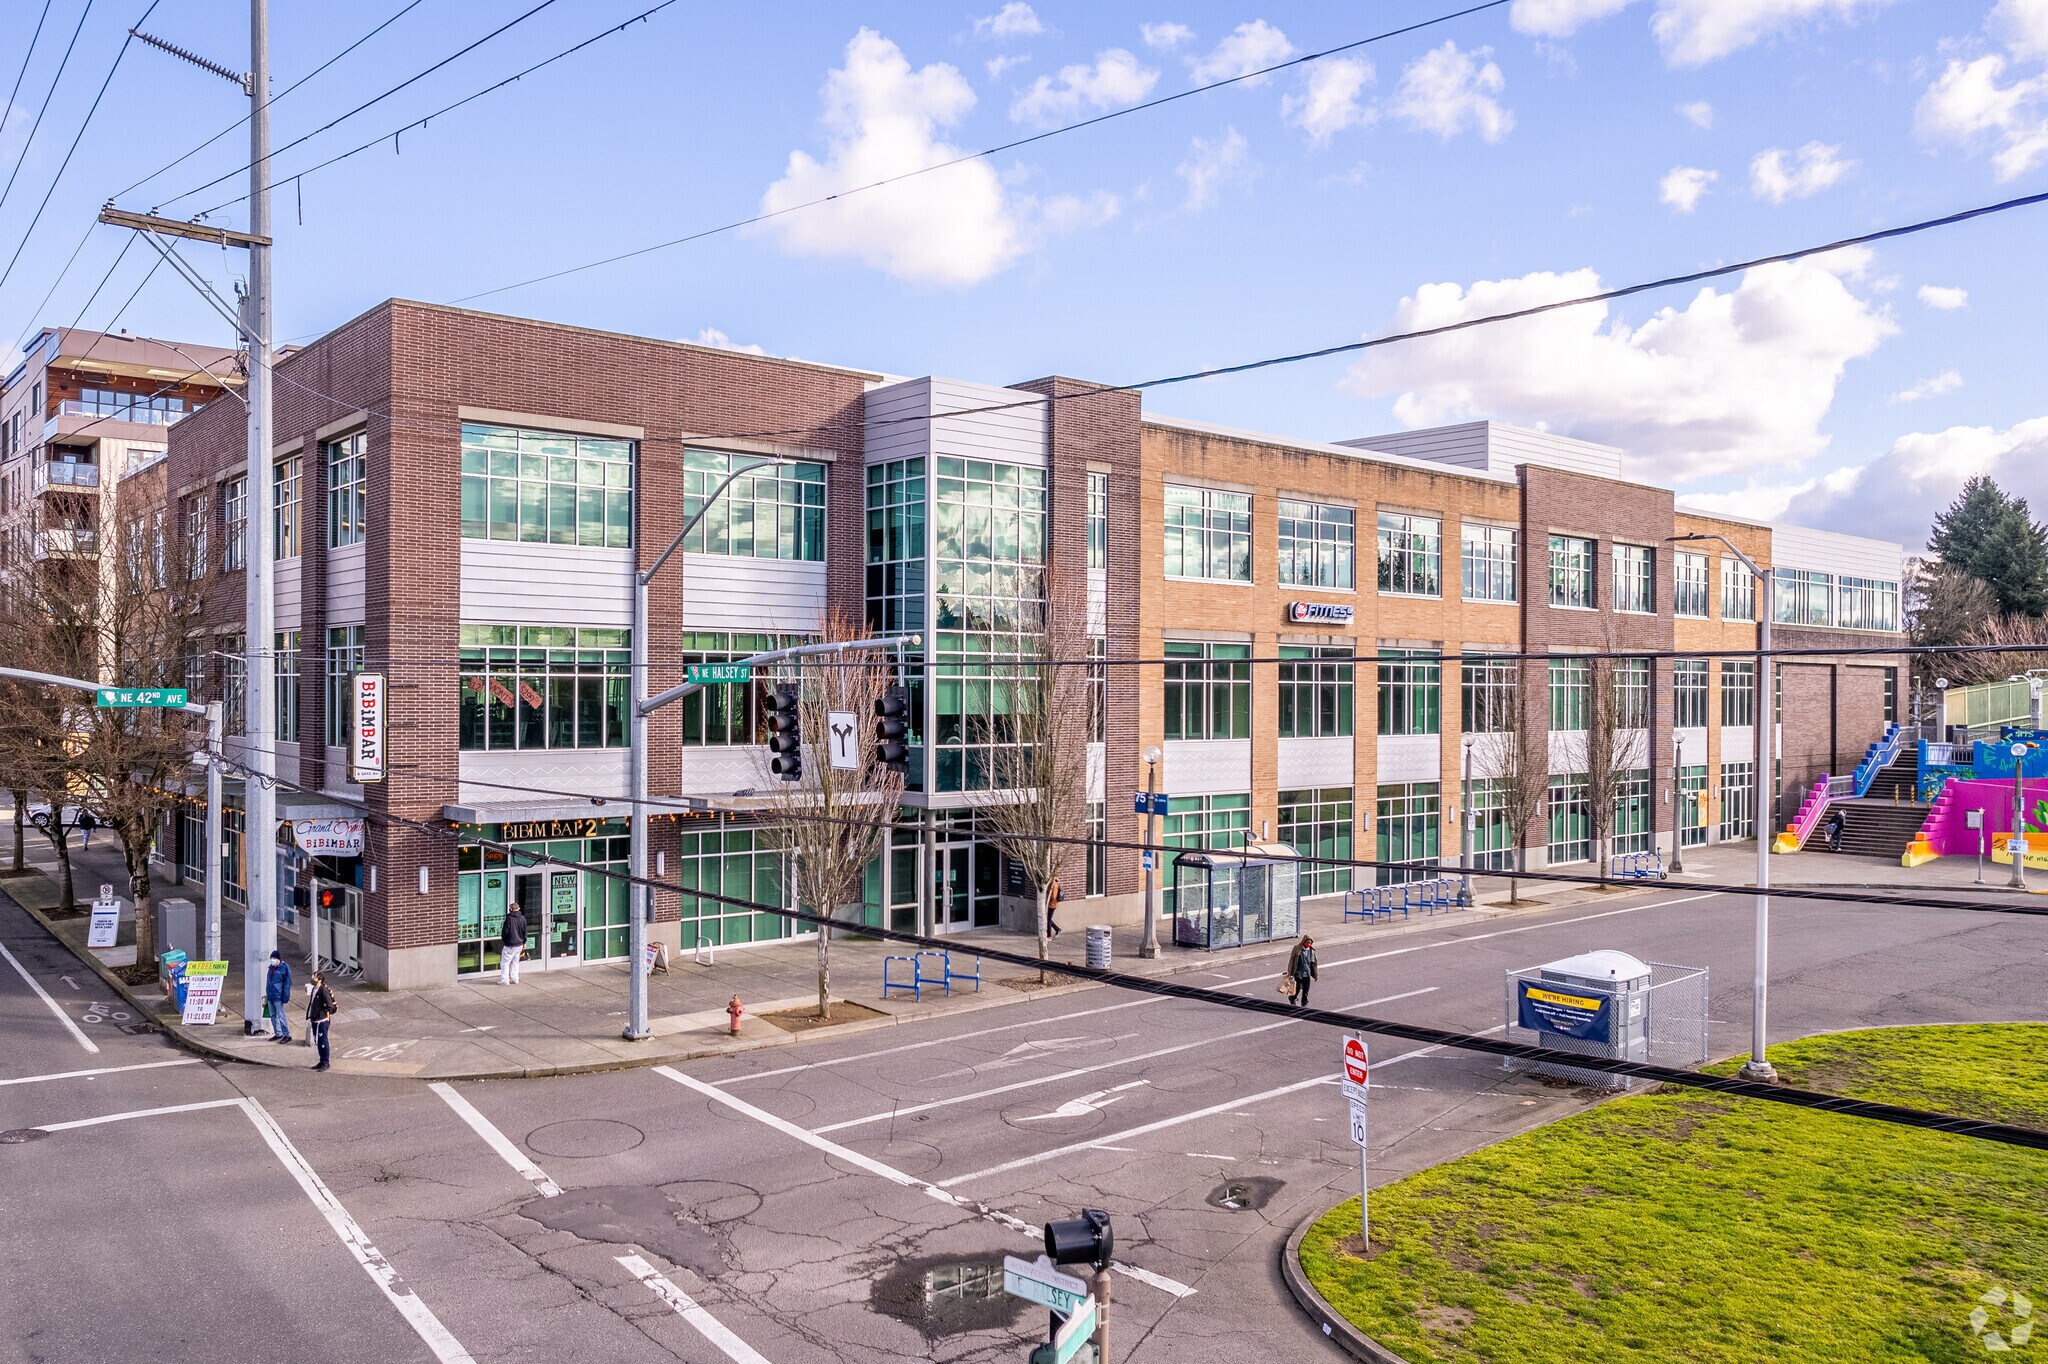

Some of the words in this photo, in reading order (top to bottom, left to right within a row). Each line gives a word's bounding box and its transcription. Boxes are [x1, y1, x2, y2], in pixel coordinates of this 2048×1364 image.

[1308, 604, 1353, 618] FITNESS
[702, 668, 709, 678] NE
[712, 666, 738, 679] HALSEY
[741, 669, 747, 678] ST
[471, 681, 481, 691] 12
[121, 693, 133, 702] NE
[136, 692, 161, 704] 42ND
[166, 694, 183, 704] AVE
[361, 681, 376, 760] BiBiMBAR
[1135, 792, 1146, 803] 75
[296, 821, 333, 834] Grand
[504, 822, 546, 839] BIBIM
[585, 818, 597, 837] 2
[555, 876, 575, 884] NEW
[1542, 993, 1560, 1001] WE'RE
[1562, 997, 1584, 1006] HIRING
[1347, 1047, 1354, 1055] DO
[1355, 1050, 1364, 1059] NOT
[1350, 1067, 1363, 1079] ENTER
[1351, 1101, 1365, 1113] SPEED
[1353, 1122, 1364, 1142] 10
[1052, 1276, 1078, 1290] DISTRICT
